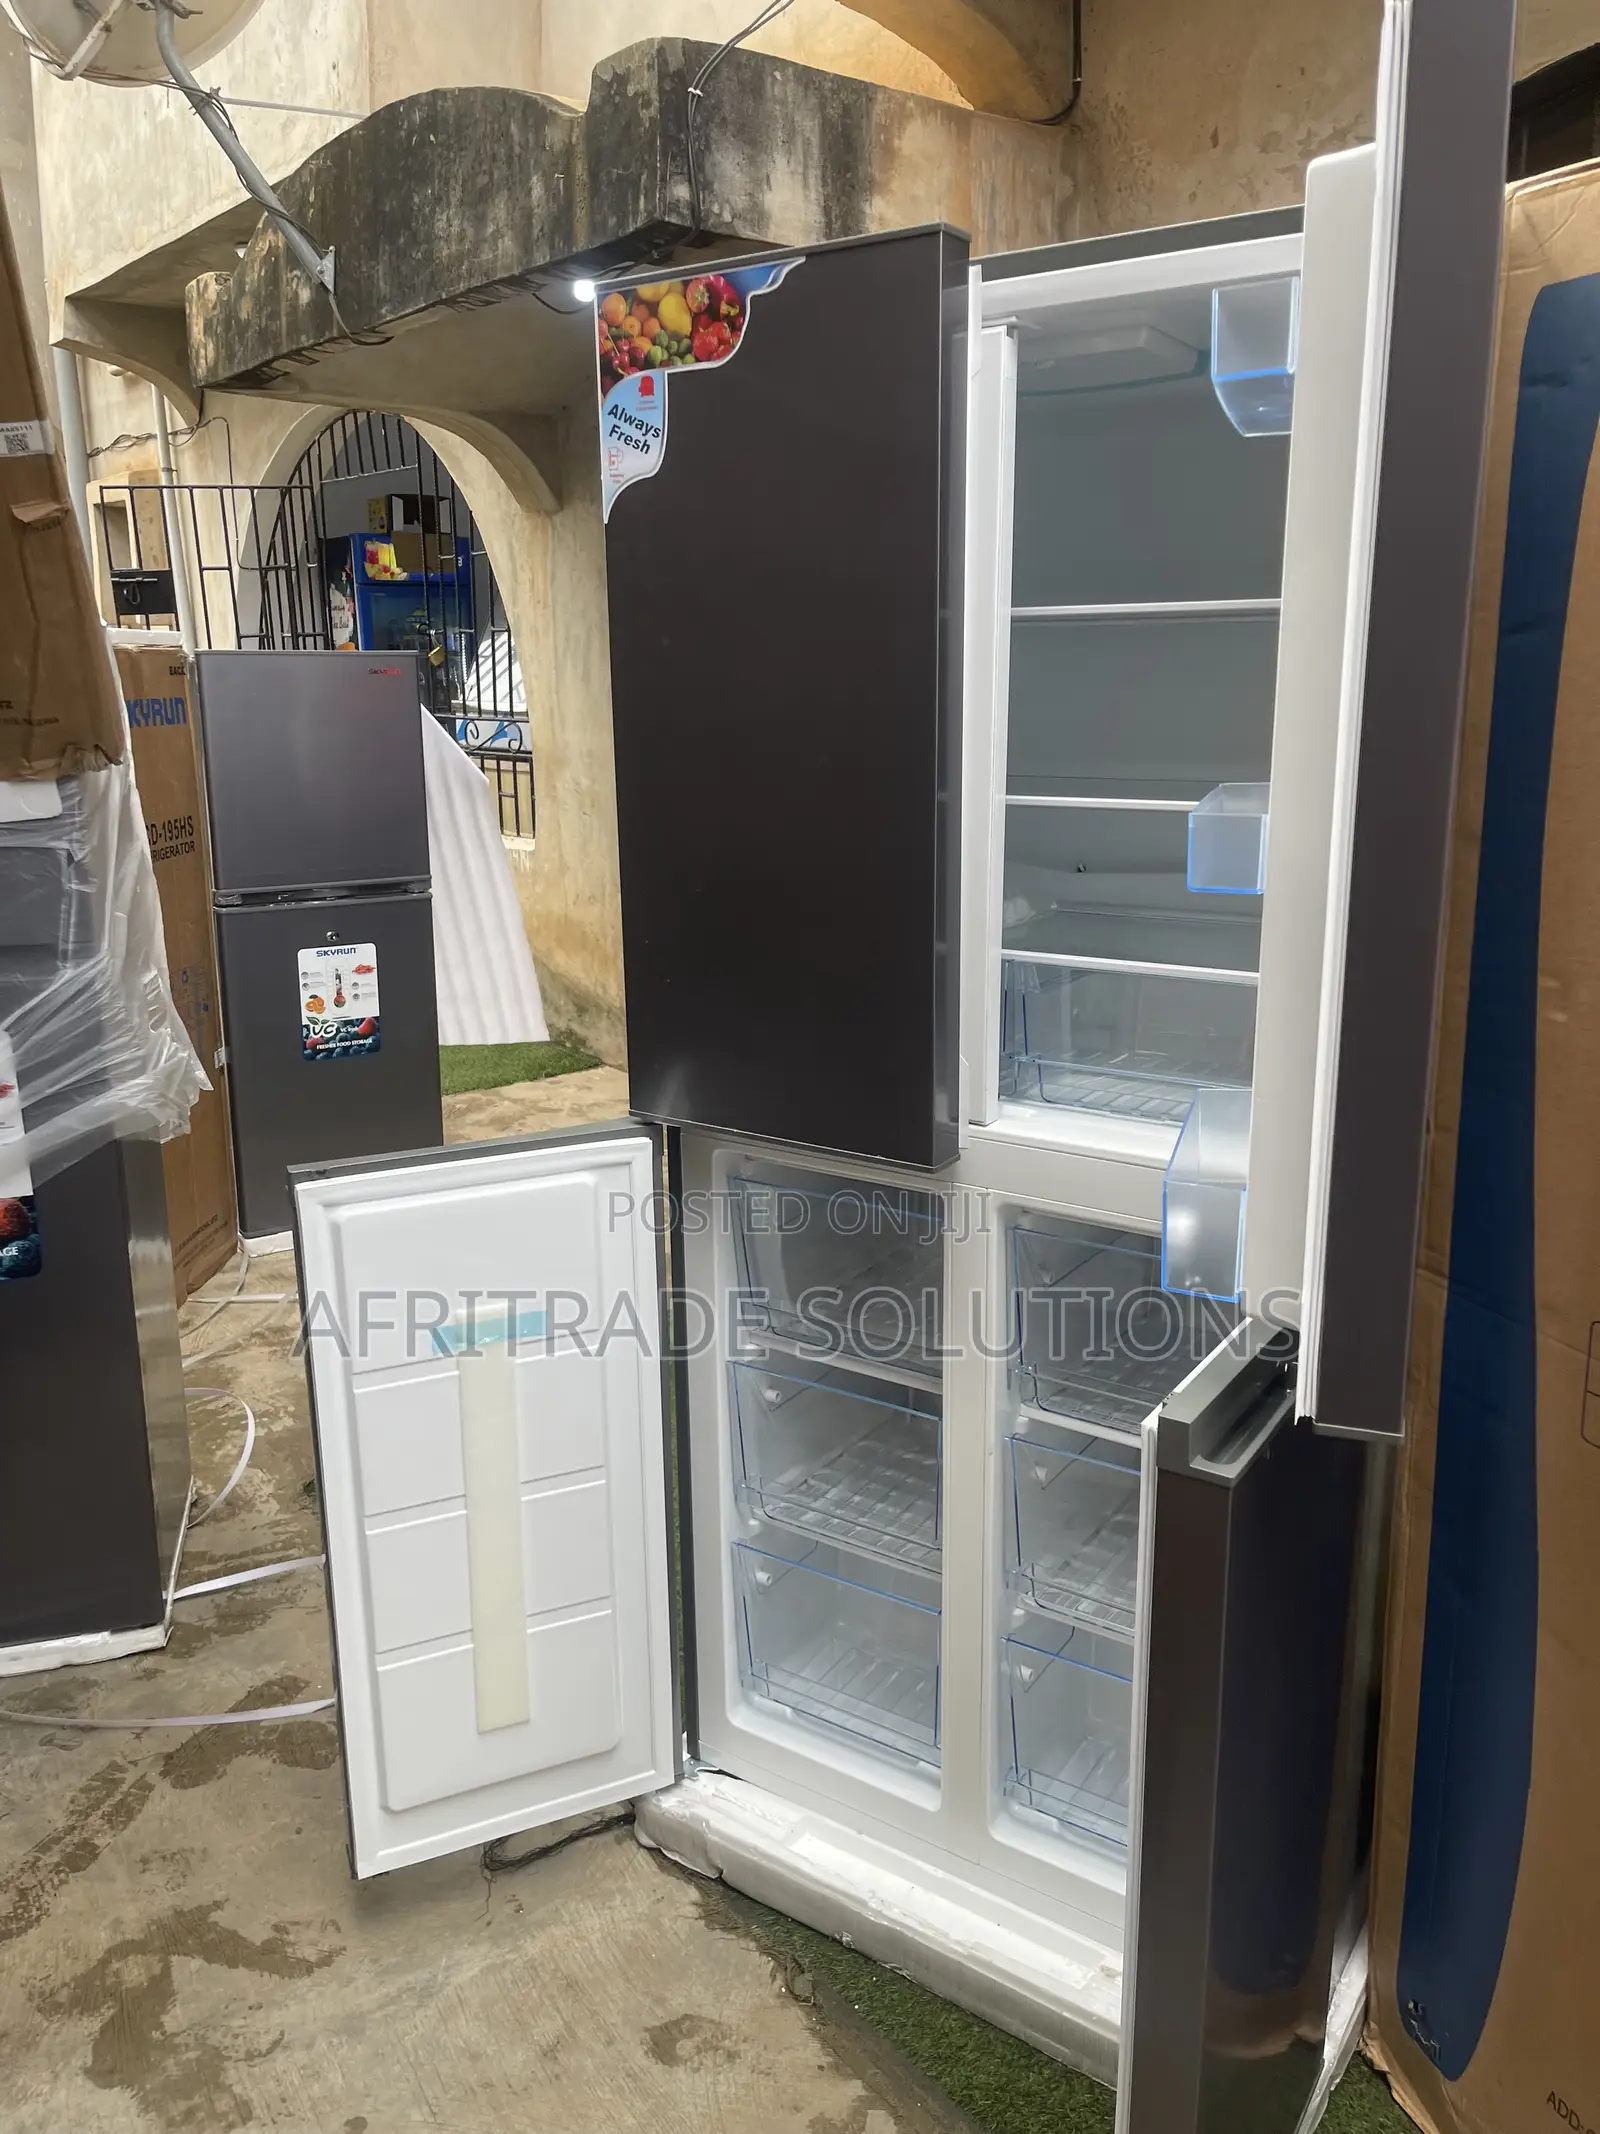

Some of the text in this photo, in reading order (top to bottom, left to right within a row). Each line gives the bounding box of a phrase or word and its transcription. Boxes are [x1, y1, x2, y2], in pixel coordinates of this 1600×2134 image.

[608, 404, 661, 438] Always
[609, 424, 650, 455] Fresh
[125, 697, 186, 728] KYRUN
[151, 841, 195, 863] RIGERATOR
[316, 948, 356, 957] SKYRUN
